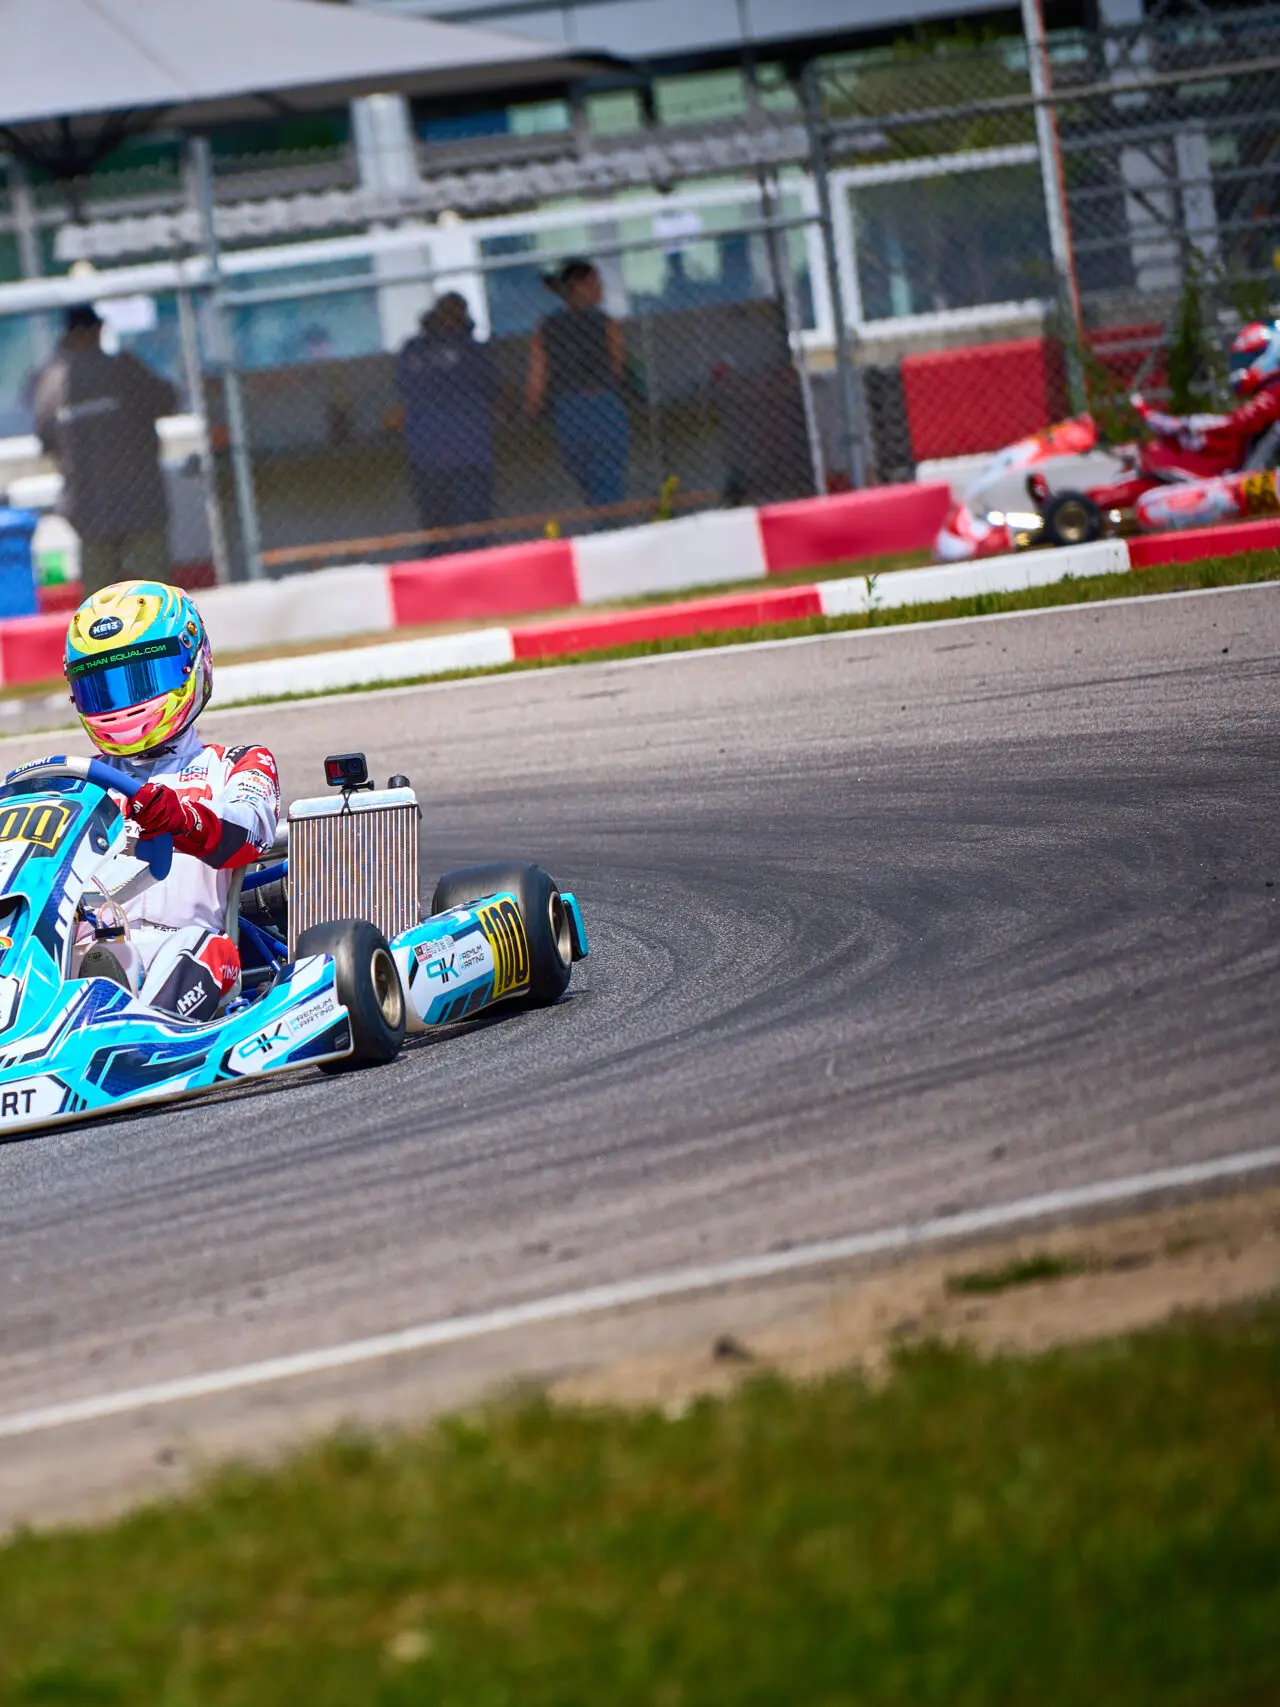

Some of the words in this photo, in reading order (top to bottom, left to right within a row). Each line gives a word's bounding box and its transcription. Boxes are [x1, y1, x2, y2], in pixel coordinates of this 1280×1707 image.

[86, 657, 109, 669] THAN
[110, 644, 167, 662] EQUAL.COM
[482, 901, 529, 993] 100
[290, 998, 332, 1026] PREMIUM
[293, 1005, 335, 1031] KARTING
